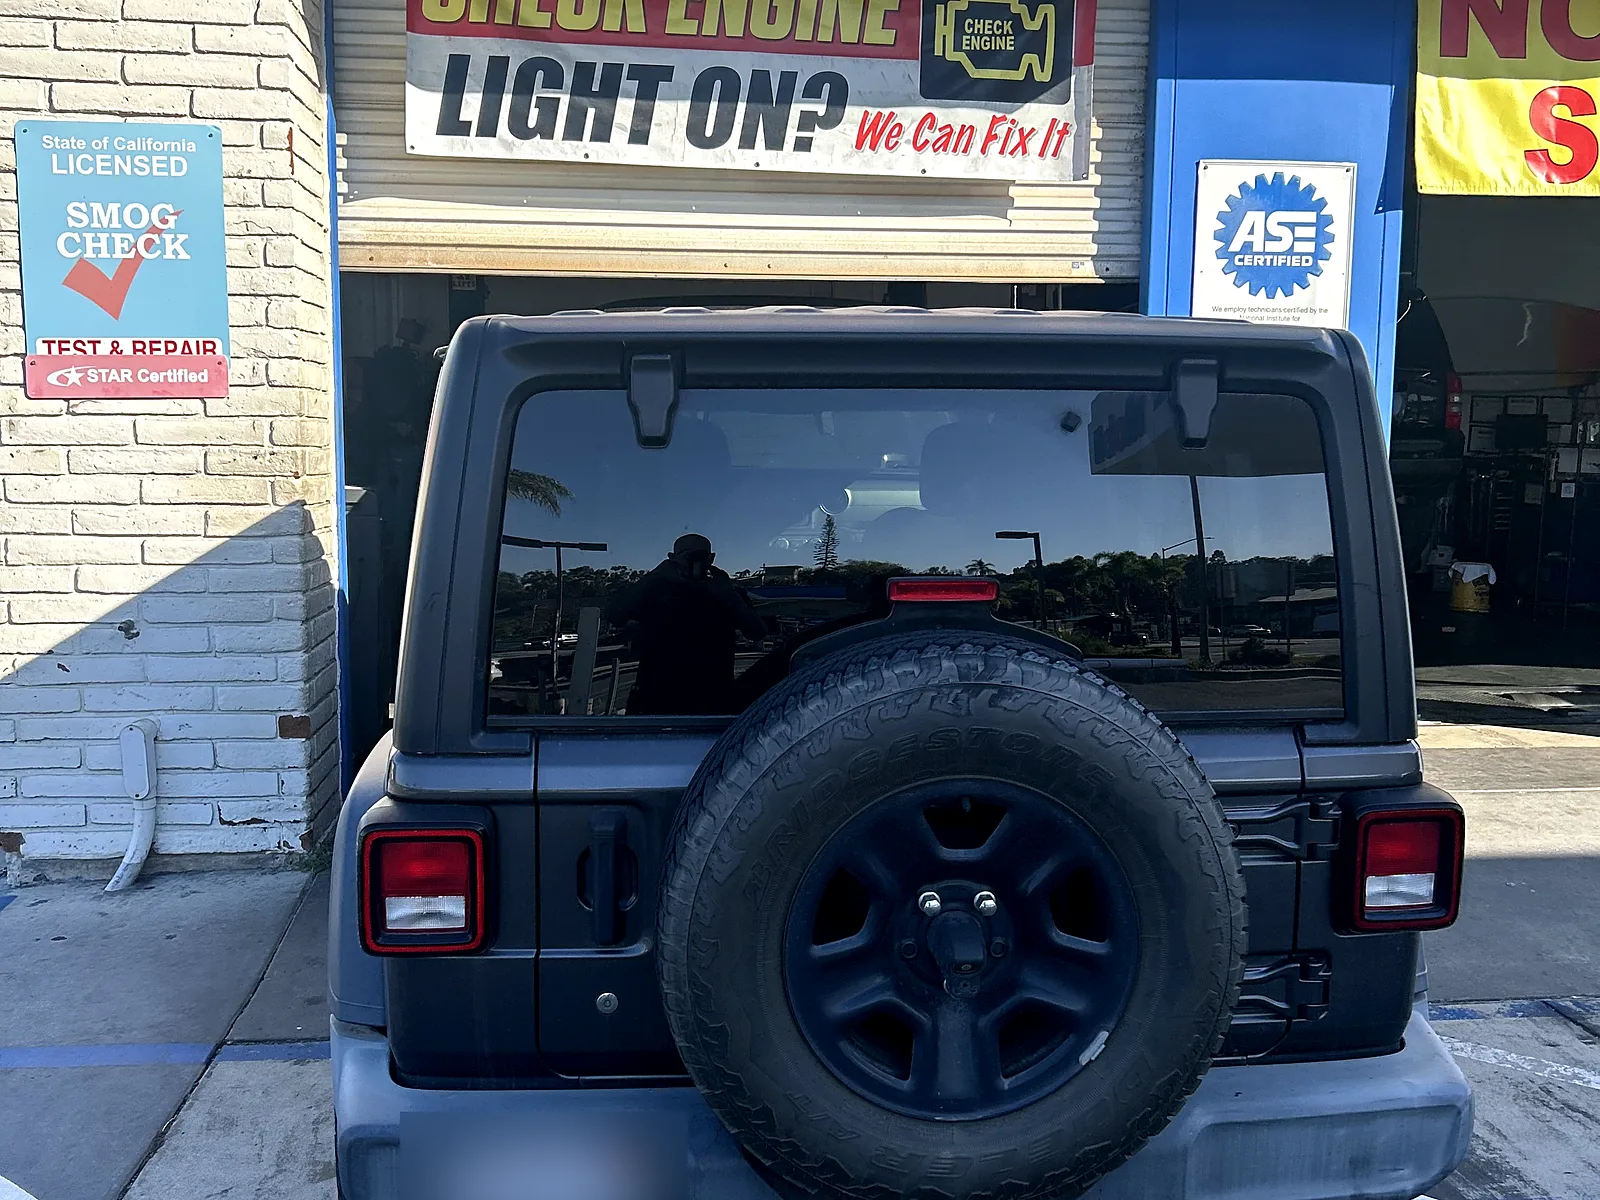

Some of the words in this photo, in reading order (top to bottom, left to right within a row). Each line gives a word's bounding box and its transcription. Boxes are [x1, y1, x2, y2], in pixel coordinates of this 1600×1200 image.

[964, 18, 1013, 34] CHECK
[962, 35, 1015, 51] ENGINE
[436, 53, 675, 145] LIGHT
[685, 65, 849, 152] ON?
[42, 135, 86, 150] State
[91, 136, 109, 150] of
[113, 136, 197, 153] California
[854, 109, 903, 152] We
[912, 111, 975, 154] Can
[980, 113, 1036, 157] Fix
[1038, 117, 1072, 159] It
[1524, 85, 1599, 184] S
[51, 153, 188, 177] LICENSED
[66, 202, 178, 229] SMOG
[1227, 210, 1318, 253] ASE
[56, 232, 191, 260] CHECK
[1233, 254, 1313, 267] CERTIFIED
[1211, 305, 1223, 313] We
[1223, 306, 1247, 314] employ
[1309, 306, 1317, 315] by
[87, 368, 133, 383] STAR
[137, 368, 209, 383] Certified
[743, 726, 1118, 901] BRIDGESTONE
